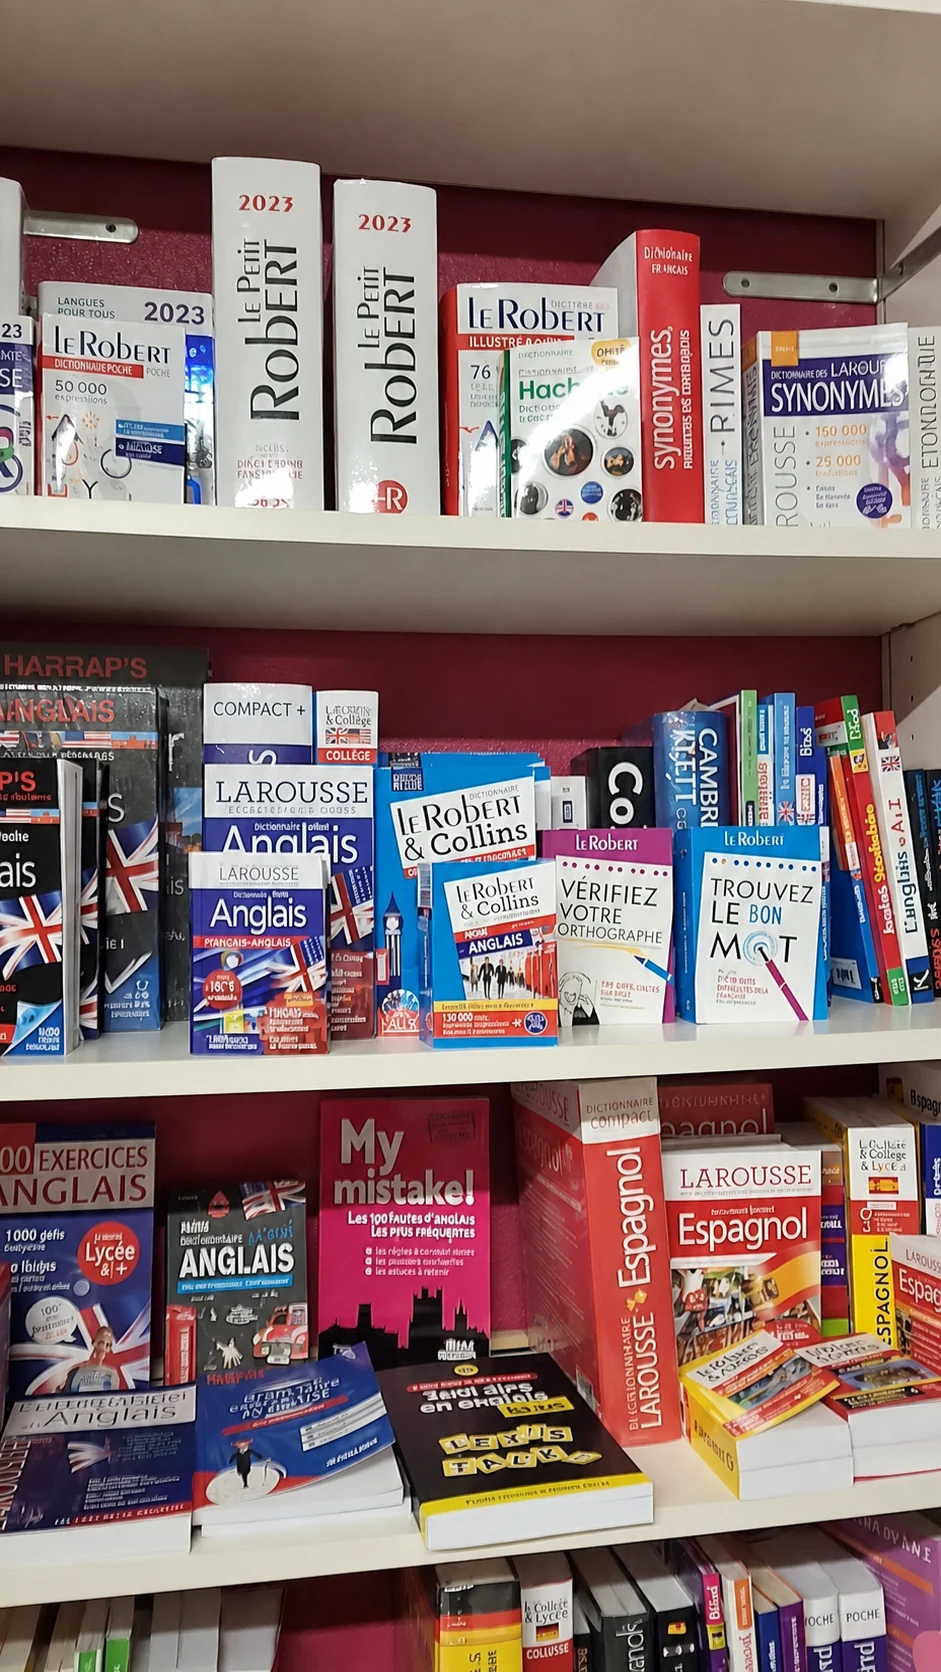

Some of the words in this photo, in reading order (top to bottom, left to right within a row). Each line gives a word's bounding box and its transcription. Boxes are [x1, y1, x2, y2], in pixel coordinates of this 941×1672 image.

[238, 194, 294, 212] 2023
[358, 214, 412, 233] 2023
[58, 297, 105, 308] LANGUES
[89, 309, 115, 319] TOUS
[143, 301, 205, 325] 2023
[469, 335, 522, 348] ILLUSTRÉ
[146, 367, 171, 378] POCHE
[470, 365, 491, 380] 76
[709, 318, 735, 433] RIMES
[815, 369, 828, 379] DES
[55, 380, 74, 393] 50
[78, 382, 107, 396] 000
[841, 424, 867, 436] 000
[815, 455, 834, 467] 25
[837, 455, 862, 466] 000
[4, 654, 148, 679] HARRAP'S
[213, 702, 292, 717] COMPACT
[297, 705, 306, 716] +
[216, 781, 368, 804] LAROUSSE
[469, 785, 519, 800] DICTIONNAIRE
[608, 761, 644, 825] Co
[404, 837, 425, 861] &
[430, 823, 528, 855] Collins
[0, 853, 37, 888] ais
[219, 866, 299, 882] LAROUSSE
[560, 876, 659, 907] VÉRIFIEZ
[710, 877, 814, 904] TROUVEZ
[210, 896, 307, 936] Anglais
[460, 903, 473, 920] &
[477, 894, 539, 916] Collins
[560, 902, 622, 925] VOTRE
[711, 900, 740, 925] LE
[749, 904, 782, 925] BON
[468, 932, 524, 955] ANGLAIS
[557, 922, 663, 944] ORTHOGRAPHE
[457, 1013, 473, 1022] 000
[586, 1097, 654, 1114] DICTIONNAIRE
[590, 1110, 653, 1130] compact
[341, 1118, 404, 1176] My
[39, 1146, 148, 1172] EXERCICES
[334, 1168, 474, 1206] mistake!
[680, 1164, 812, 1189] LAROUSSE
[348, 1211, 368, 1224] Les
[370, 1213, 387, 1225] 100
[606, 1146, 657, 1288] Espagnol
[371, 1225, 387, 1238] Les
[679, 1207, 807, 1252] Espagnol
[86, 1241, 135, 1267] Lycée
[179, 1243, 295, 1279] ANGLAIS
[633, 1312, 662, 1429] LAROUSSE
[846, 1608, 881, 1623] POCHE
